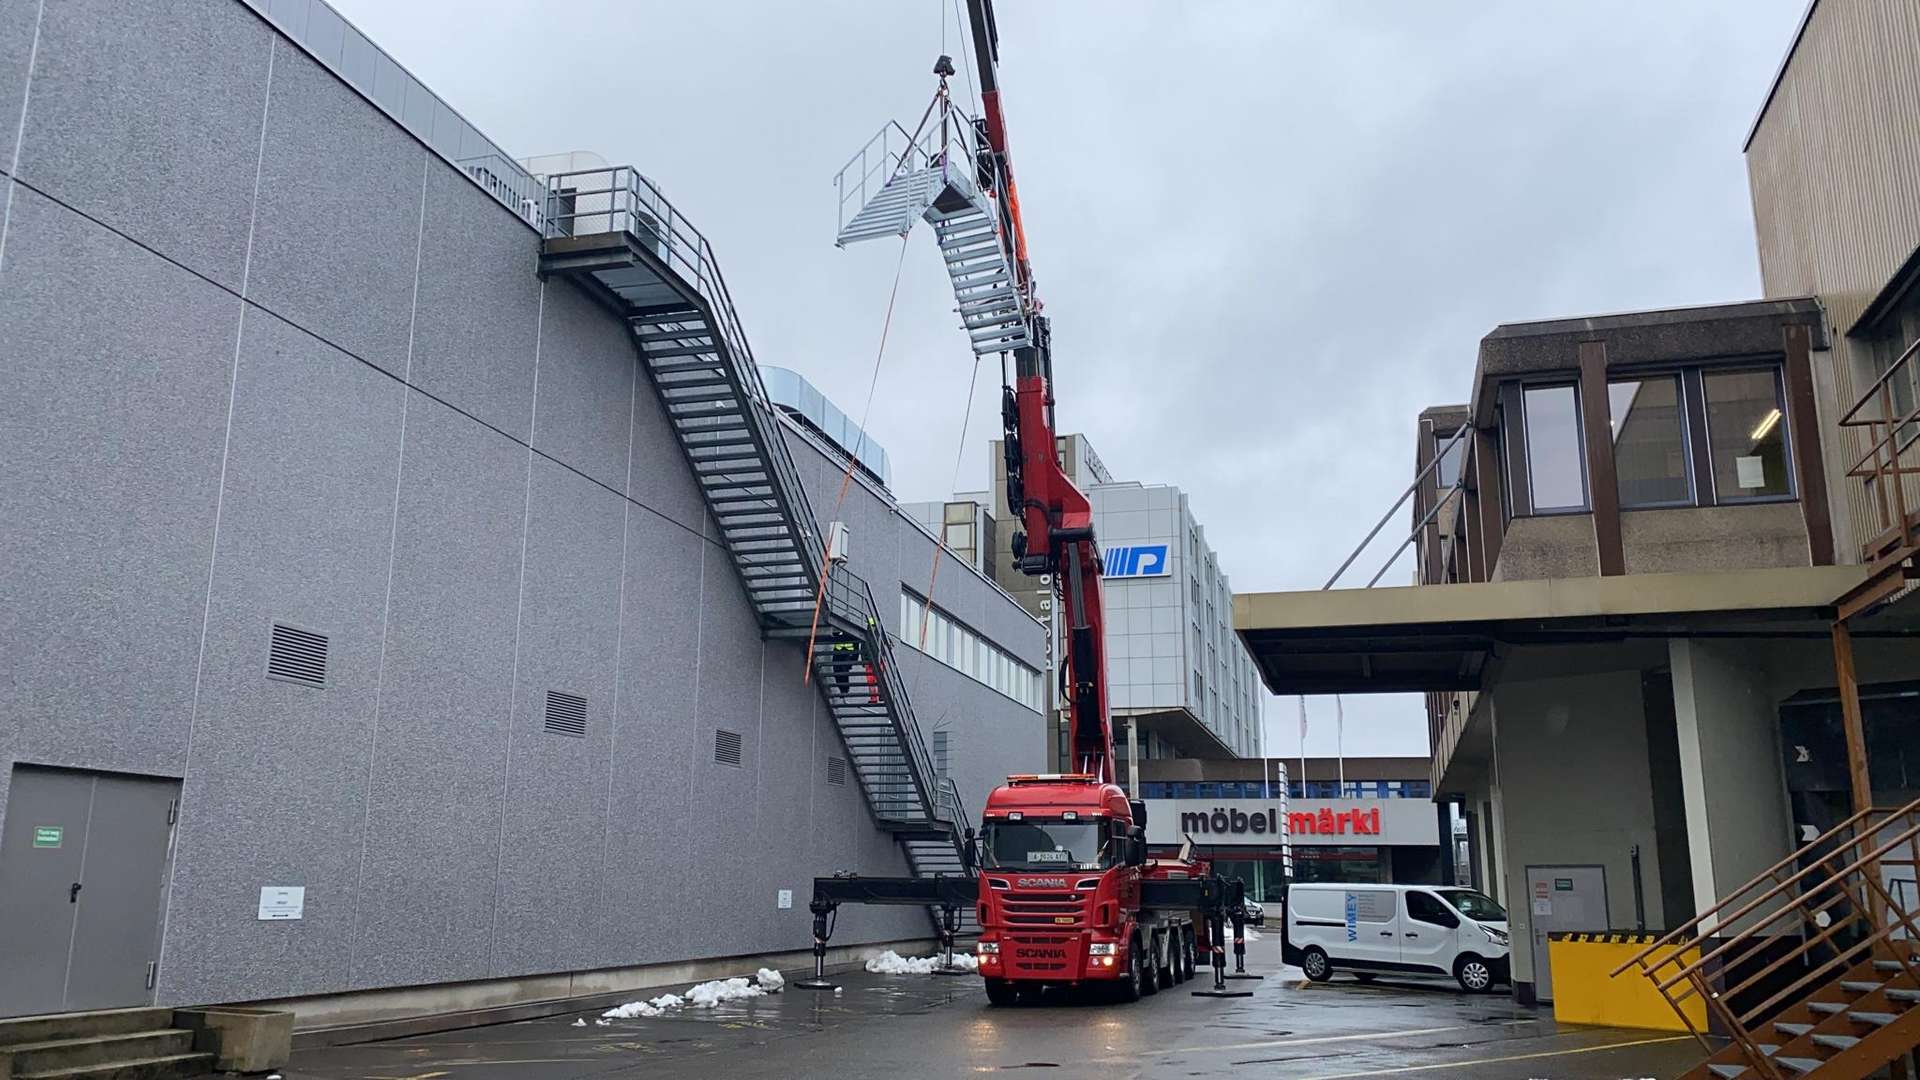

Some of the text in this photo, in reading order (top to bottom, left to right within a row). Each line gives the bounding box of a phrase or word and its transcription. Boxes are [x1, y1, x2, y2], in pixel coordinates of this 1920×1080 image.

[1181, 807, 1381, 835] möbel märki
[1017, 878, 1068, 888] SCANIA
[1016, 948, 1067, 959] SCANIA
